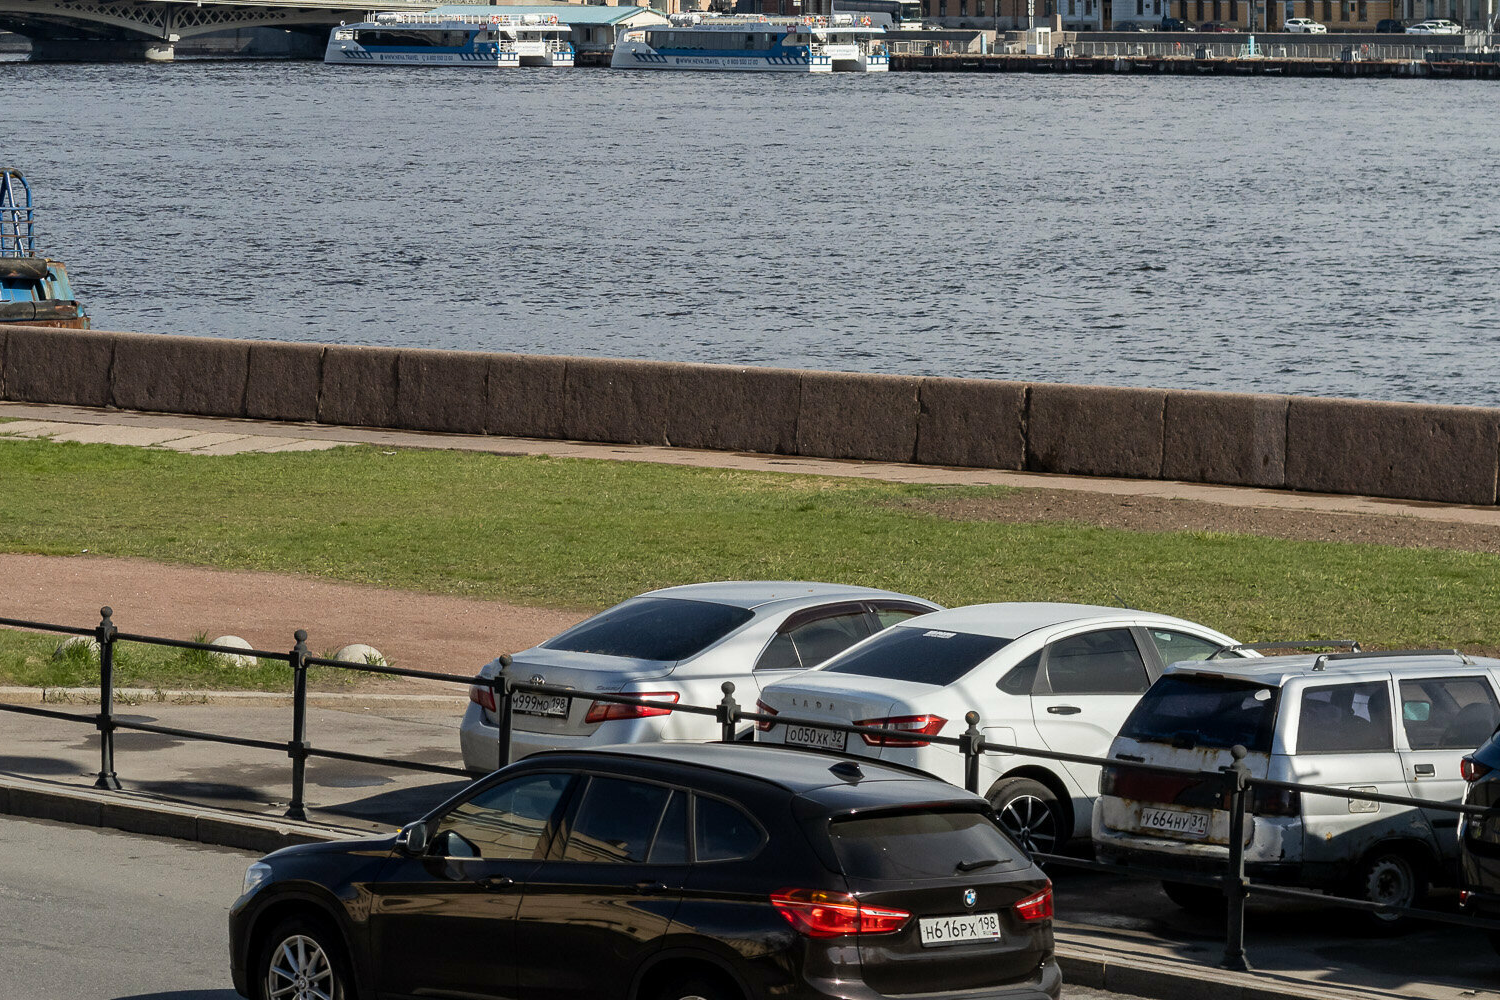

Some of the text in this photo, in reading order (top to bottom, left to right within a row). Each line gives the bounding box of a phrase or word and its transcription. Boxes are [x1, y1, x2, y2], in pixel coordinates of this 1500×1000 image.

[792, 698, 835, 710] LADA
[832, 730, 842, 743] 32
[1191, 815, 1203, 828] 31
[925, 916, 997, 940] Н616РХ 198
